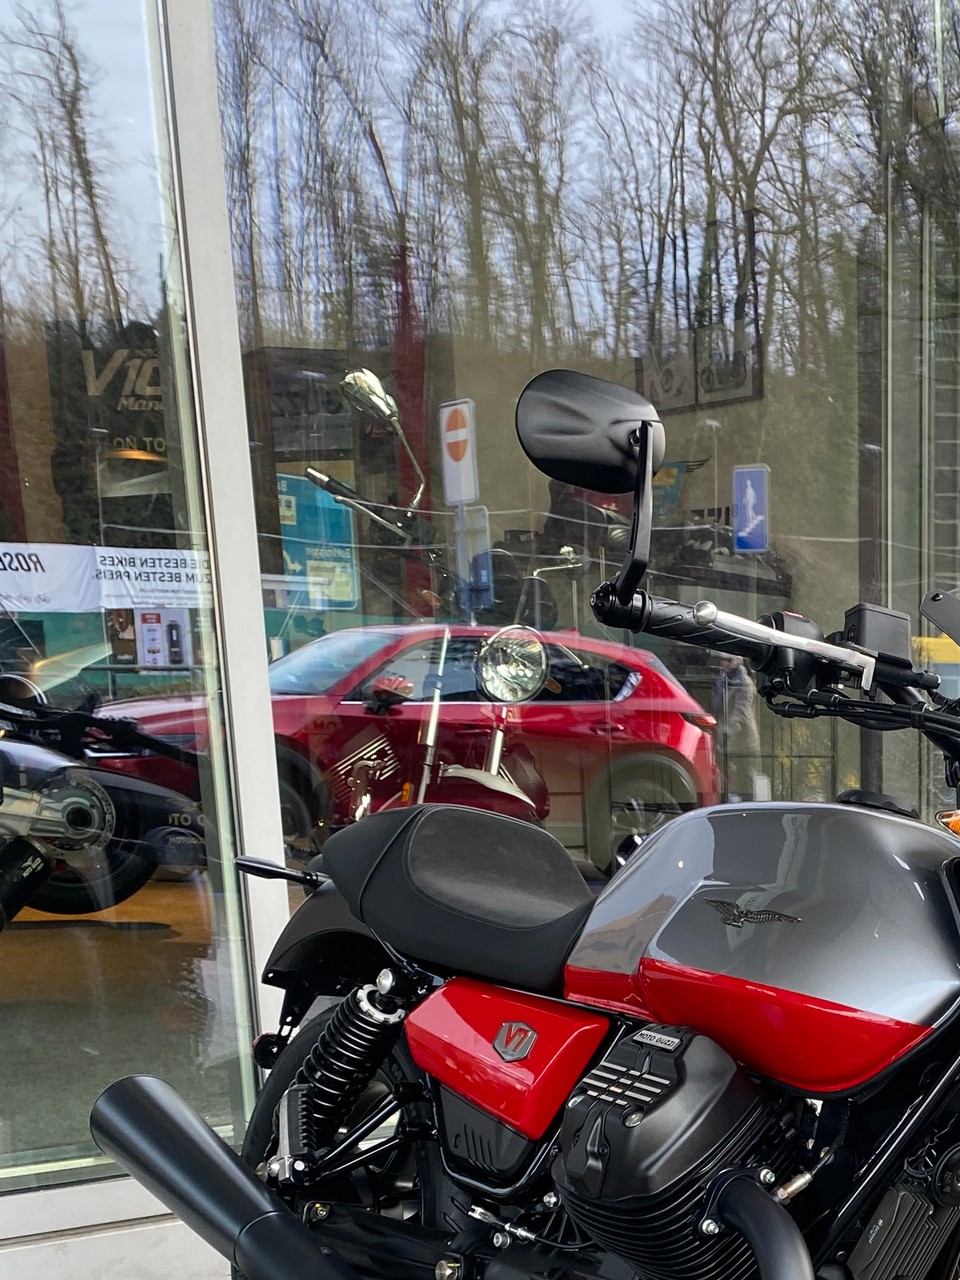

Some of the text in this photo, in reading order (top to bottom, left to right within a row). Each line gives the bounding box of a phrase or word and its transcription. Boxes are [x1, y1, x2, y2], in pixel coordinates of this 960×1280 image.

[503, 1023, 531, 1053] V7
[636, 1032, 677, 1048] MOTO GUZZI
